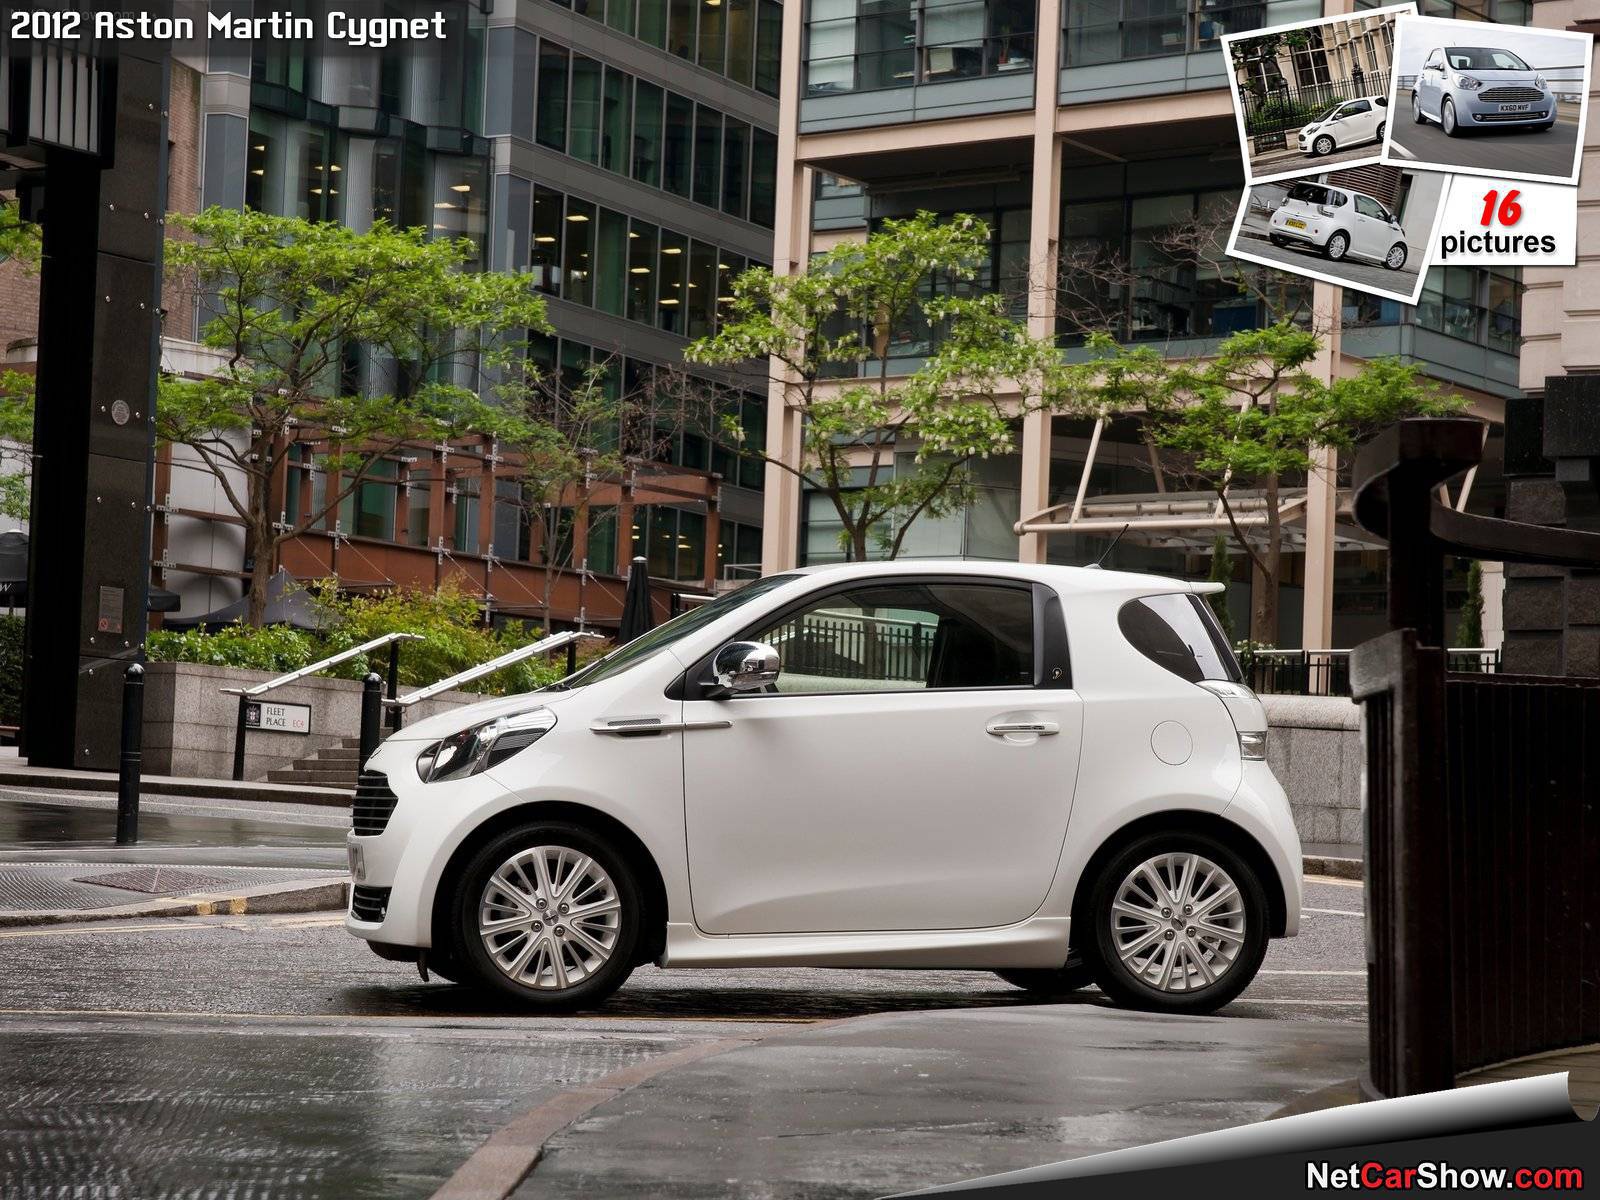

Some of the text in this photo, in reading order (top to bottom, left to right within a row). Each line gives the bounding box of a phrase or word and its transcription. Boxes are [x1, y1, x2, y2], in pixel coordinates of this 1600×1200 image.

[266, 706, 286, 717] FLEET
[265, 717, 305, 729] PLACE EC4
